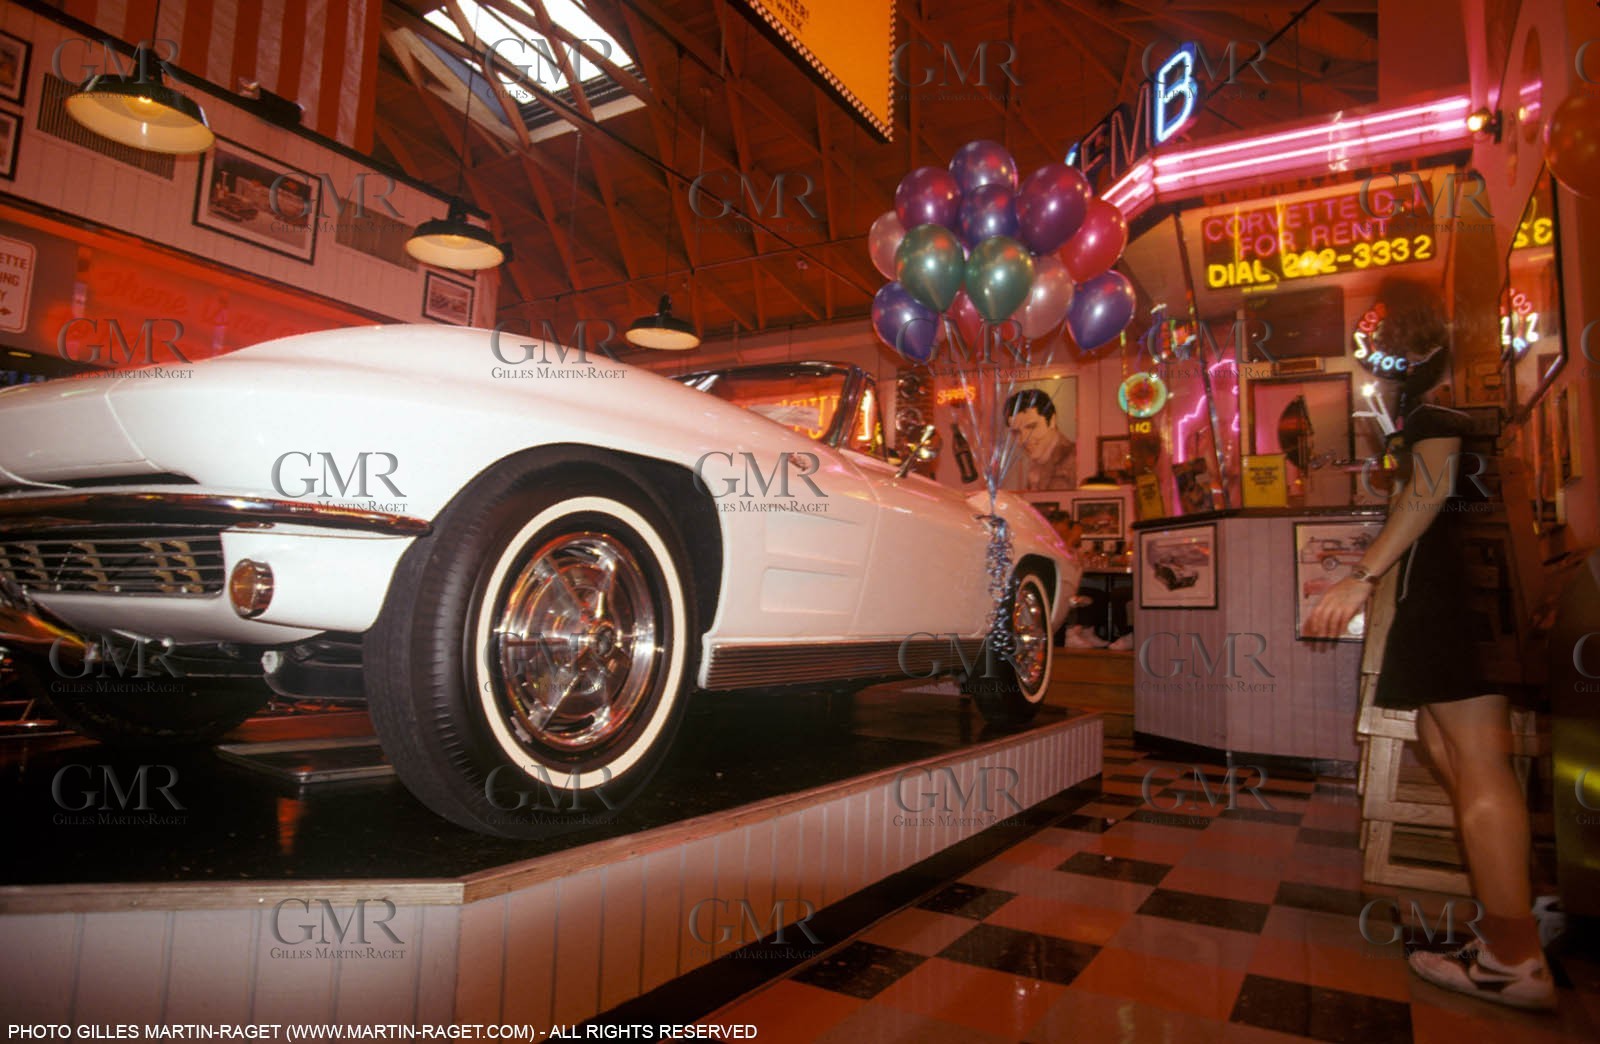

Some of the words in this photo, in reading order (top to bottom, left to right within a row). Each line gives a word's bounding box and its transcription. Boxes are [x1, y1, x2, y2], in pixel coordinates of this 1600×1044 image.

[1205, 194, 1357, 241] CORVETTE
[1239, 232, 1296, 259] FOR
[1310, 215, 1391, 247] RENT
[1207, 258, 1272, 288] DIAL
